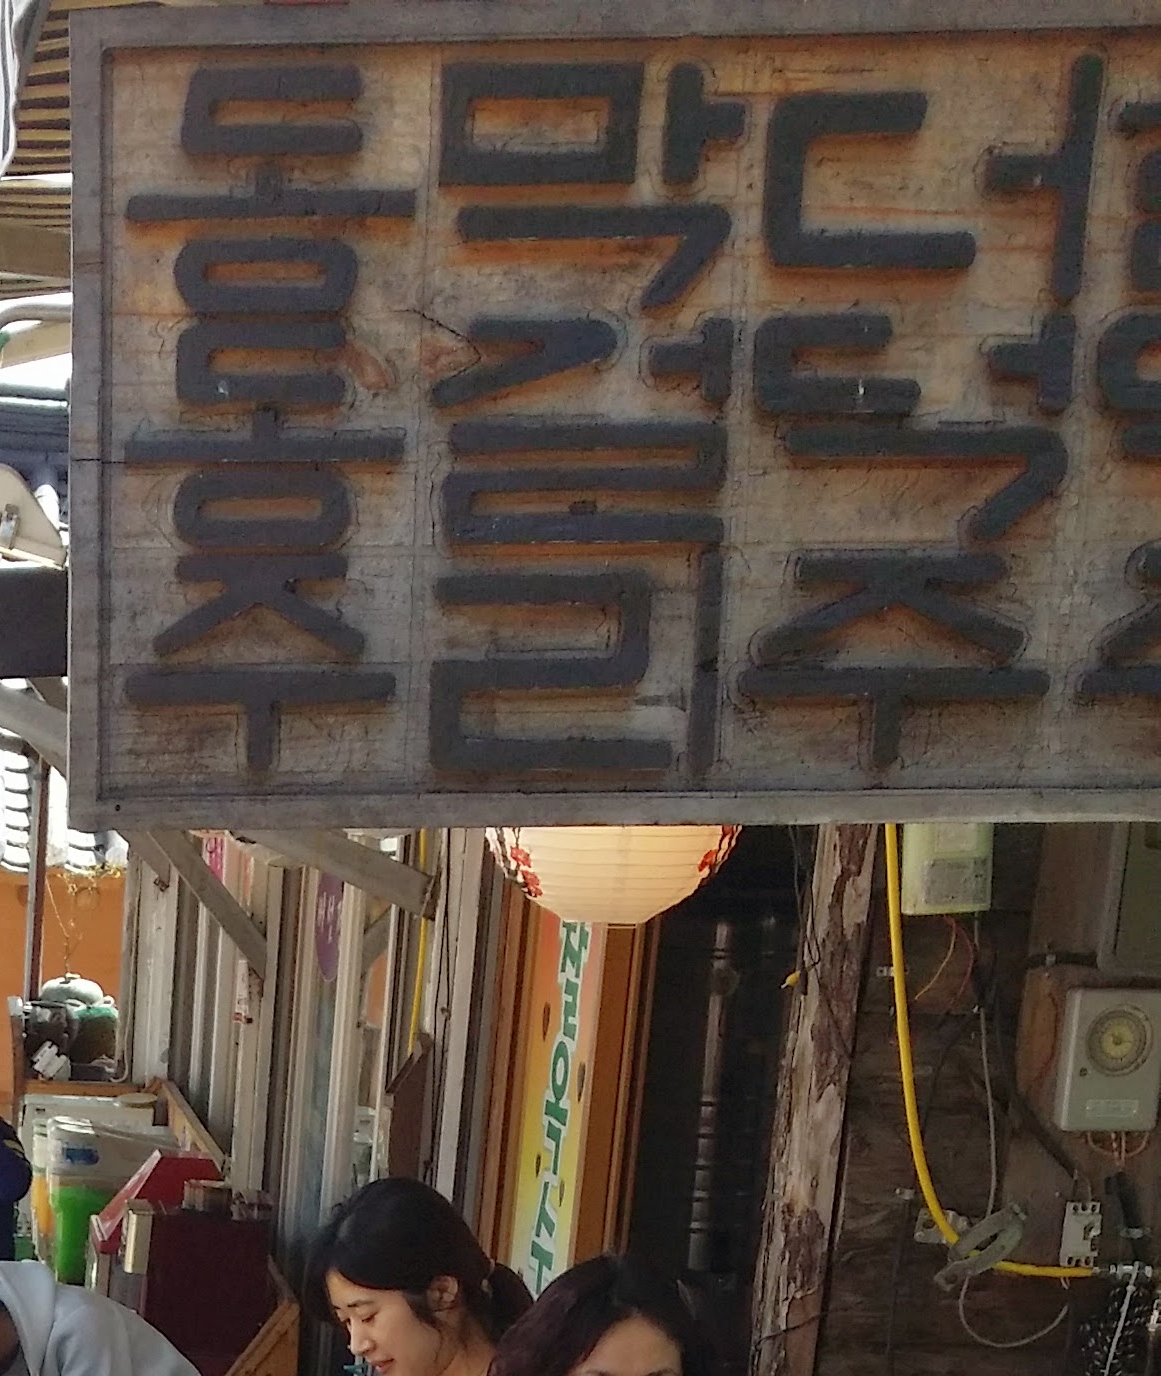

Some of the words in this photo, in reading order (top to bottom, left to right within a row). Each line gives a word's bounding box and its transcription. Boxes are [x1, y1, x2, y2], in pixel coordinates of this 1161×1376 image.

[125, 64, 416, 773] 동동주
[430, 60, 747, 776] 막걸리
[739, 54, 1106, 773] 더덕주
[531, 921, 589, 1297] 찰옥수
